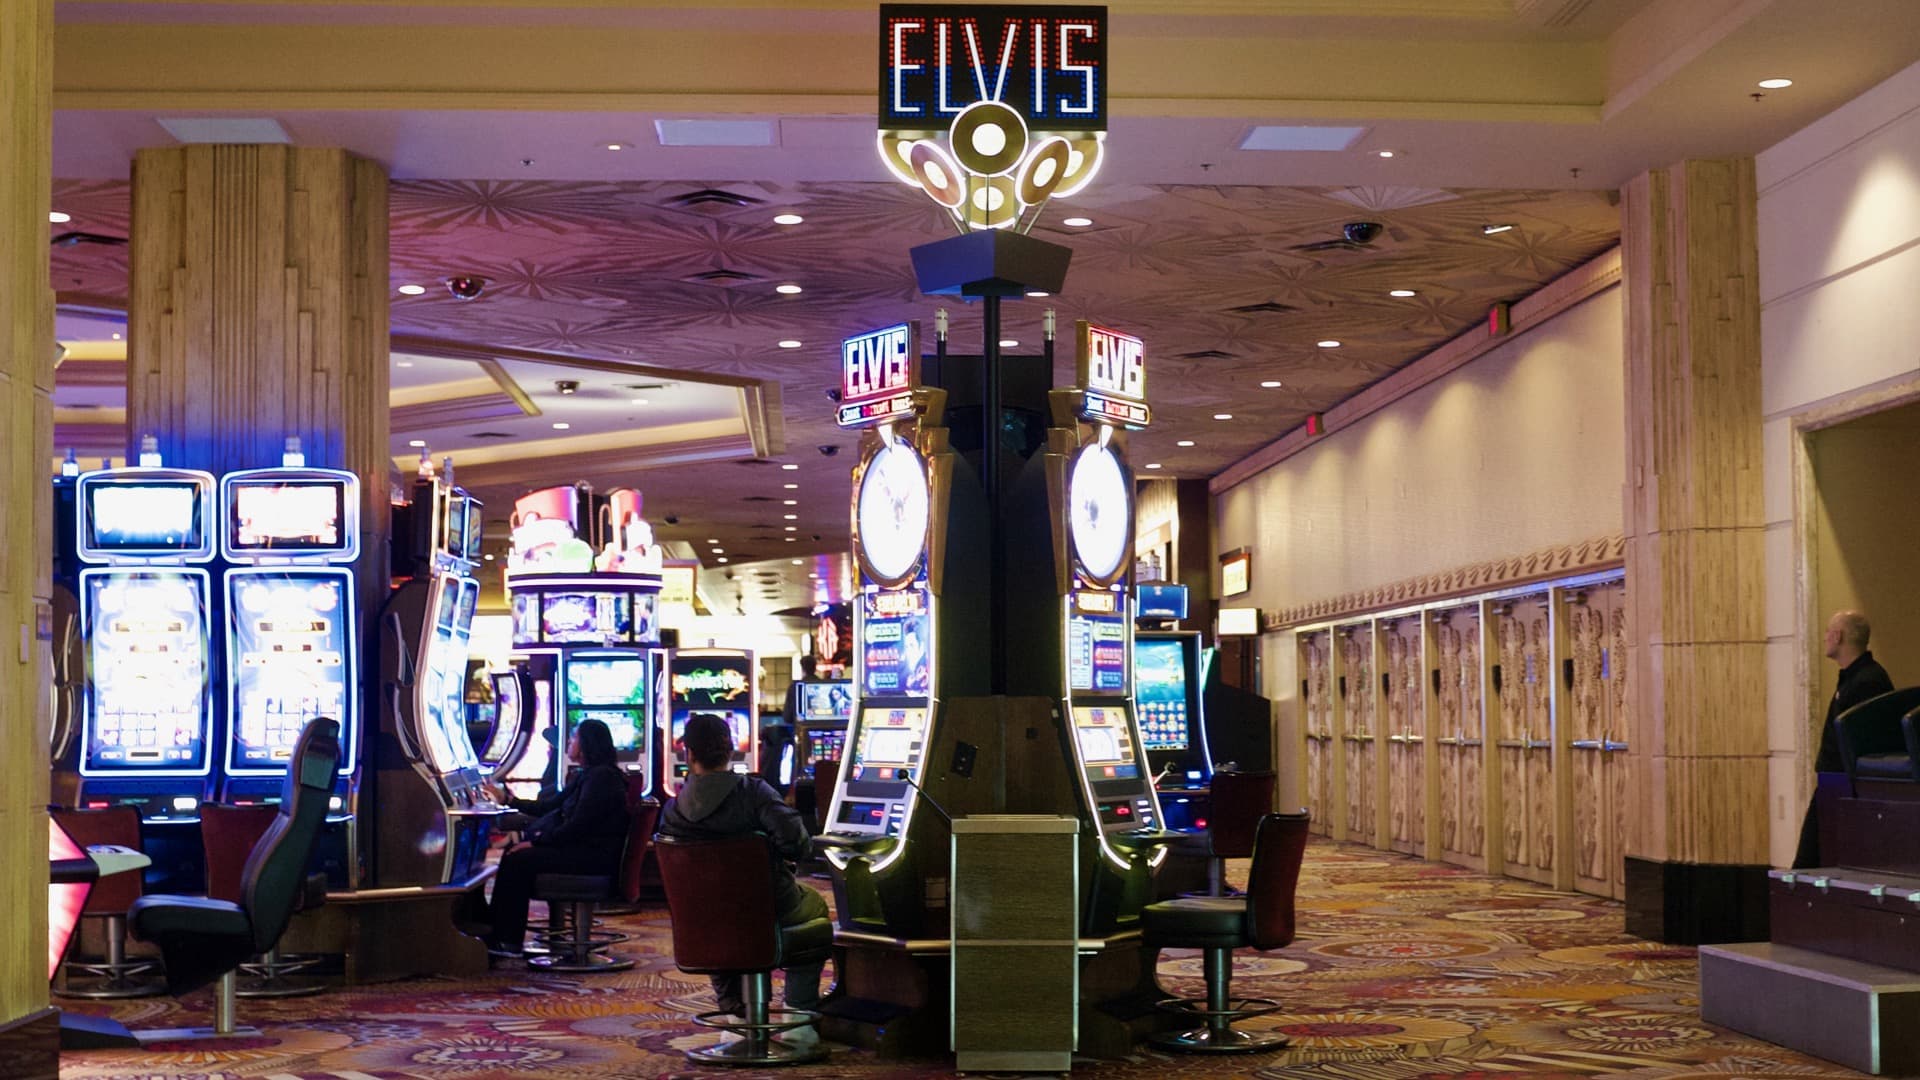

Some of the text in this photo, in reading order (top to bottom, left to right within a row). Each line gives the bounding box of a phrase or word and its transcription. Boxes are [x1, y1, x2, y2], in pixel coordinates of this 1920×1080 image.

[889, 18, 1099, 118] ELVIS
[846, 330, 906, 396] ELVIS
[1091, 331, 1142, 396] ELVIS
